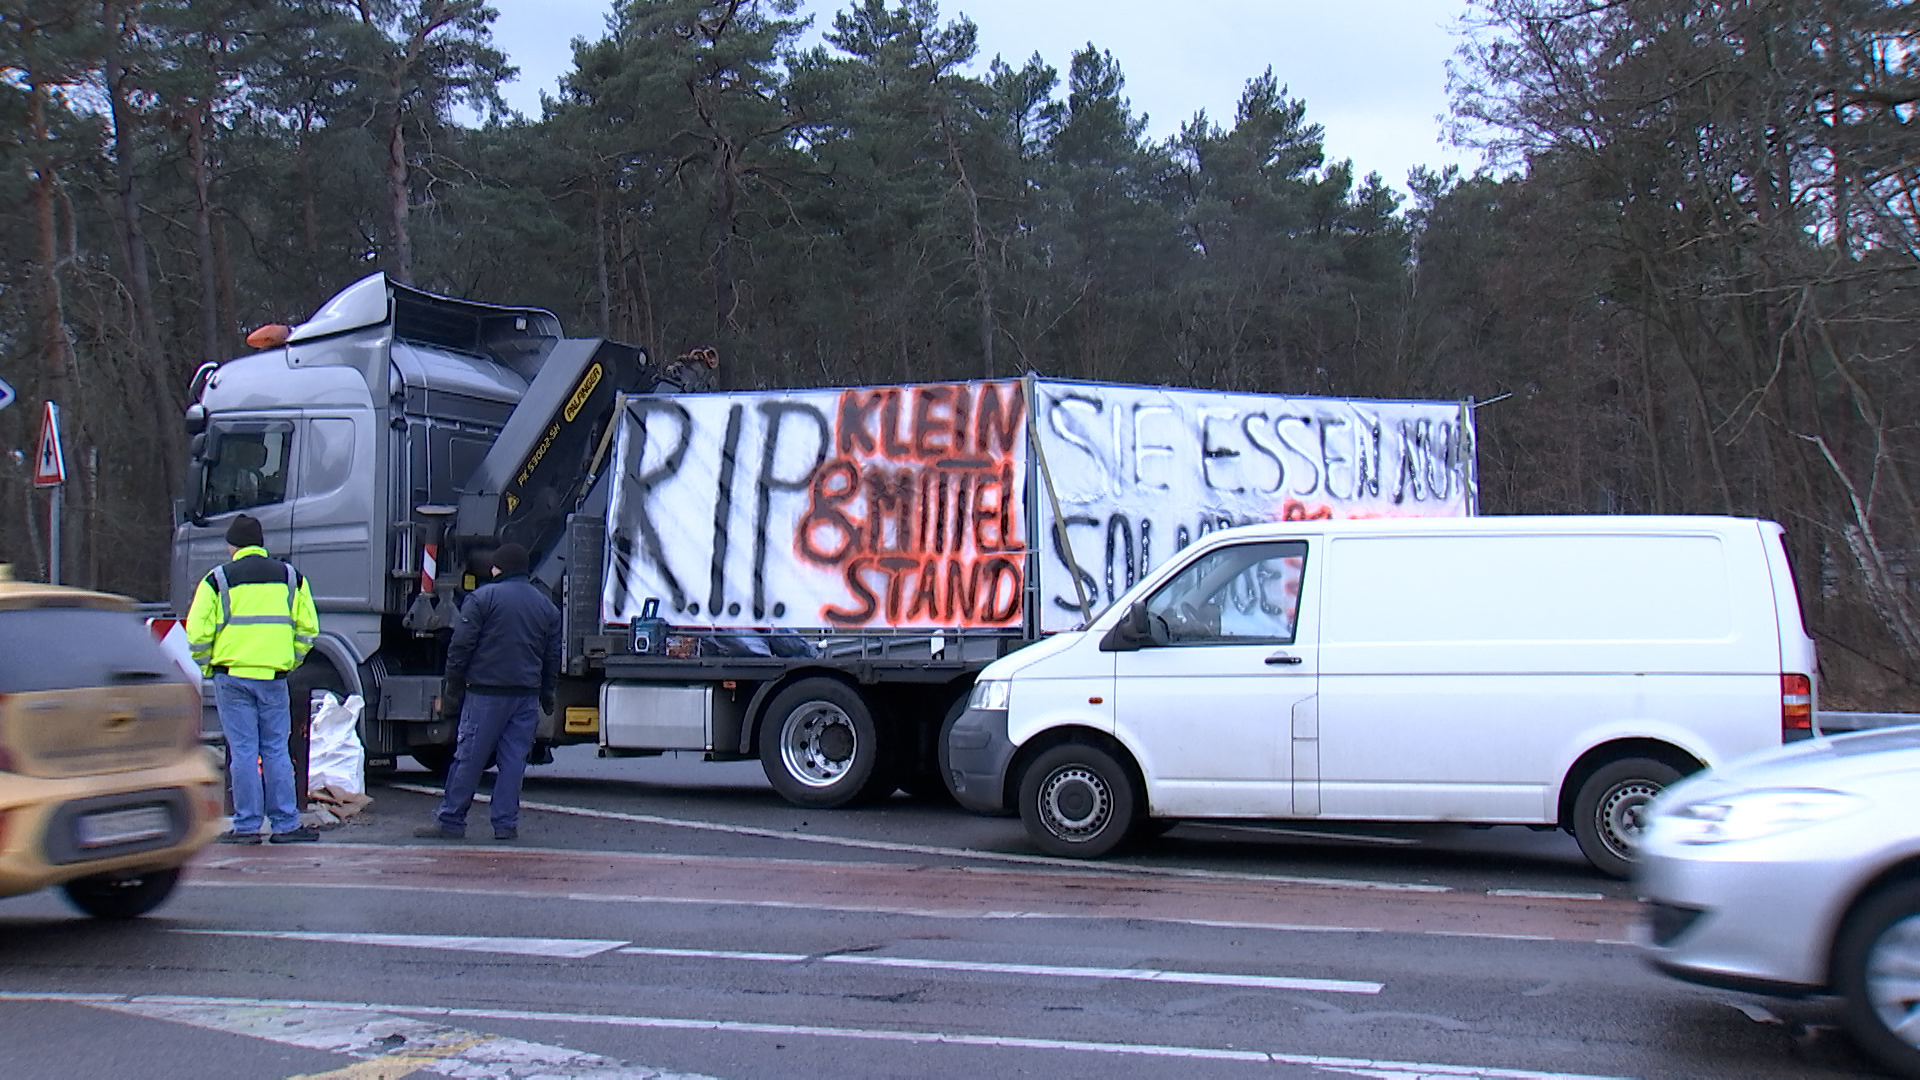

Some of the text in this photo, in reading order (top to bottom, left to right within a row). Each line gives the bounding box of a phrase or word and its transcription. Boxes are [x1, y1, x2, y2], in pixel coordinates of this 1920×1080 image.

[838, 385, 1025, 459] KLEIN
[1048, 393, 1174, 503] SIE
[1200, 405, 1382, 501] ESSEN
[612, 399, 829, 620] R.I.P.
[794, 458, 1025, 566] & MITTEL
[823, 556, 1023, 626] STAND
